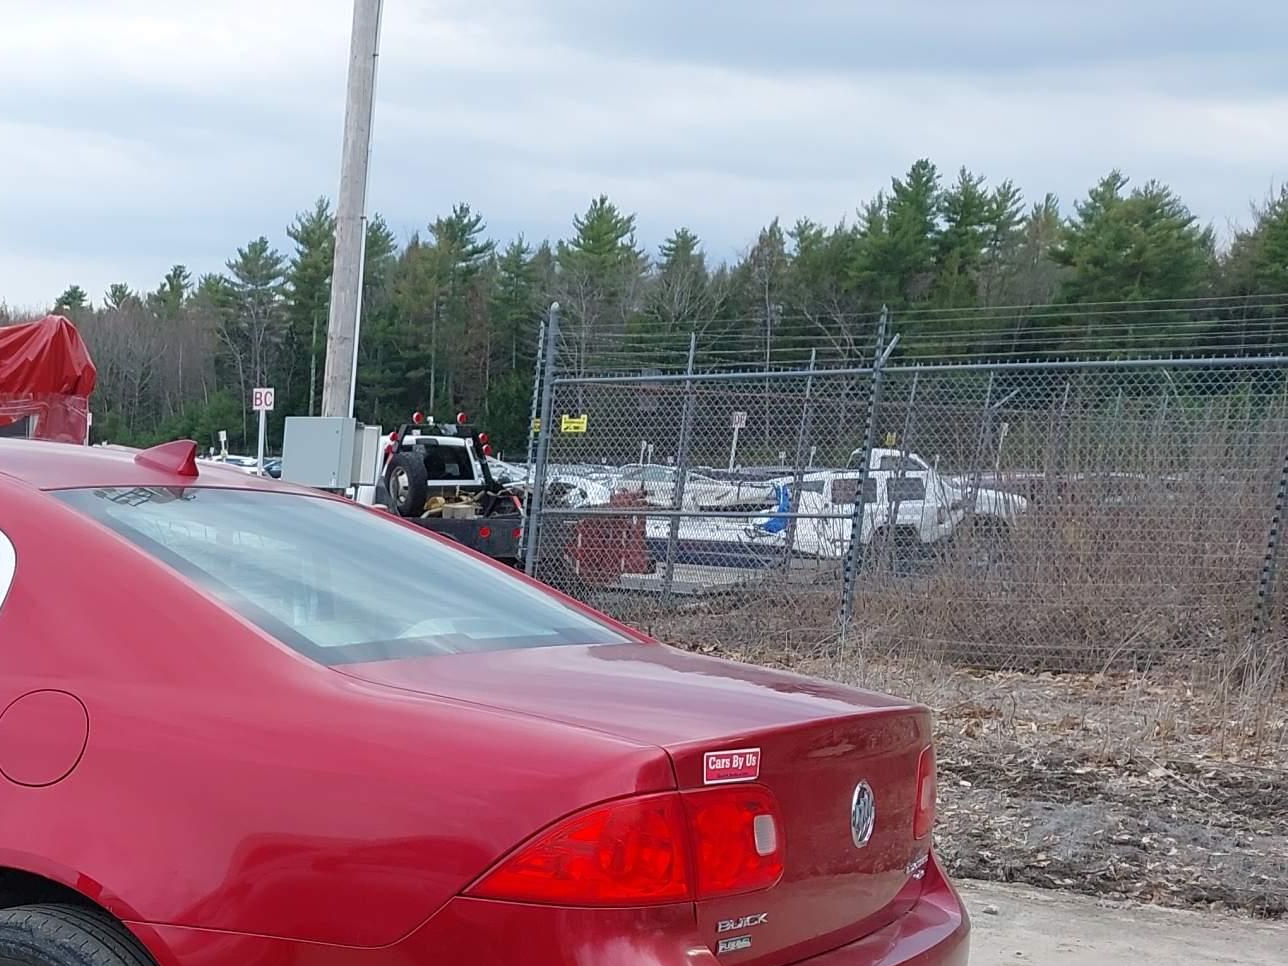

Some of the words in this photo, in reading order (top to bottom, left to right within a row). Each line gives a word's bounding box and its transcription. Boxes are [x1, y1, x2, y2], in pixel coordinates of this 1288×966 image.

[254, 391, 273, 407] BC
[708, 756, 731, 770] Cars
[732, 754, 744, 770] By
[745, 753, 757, 767] Us
[718, 912, 768, 932] BUICK
